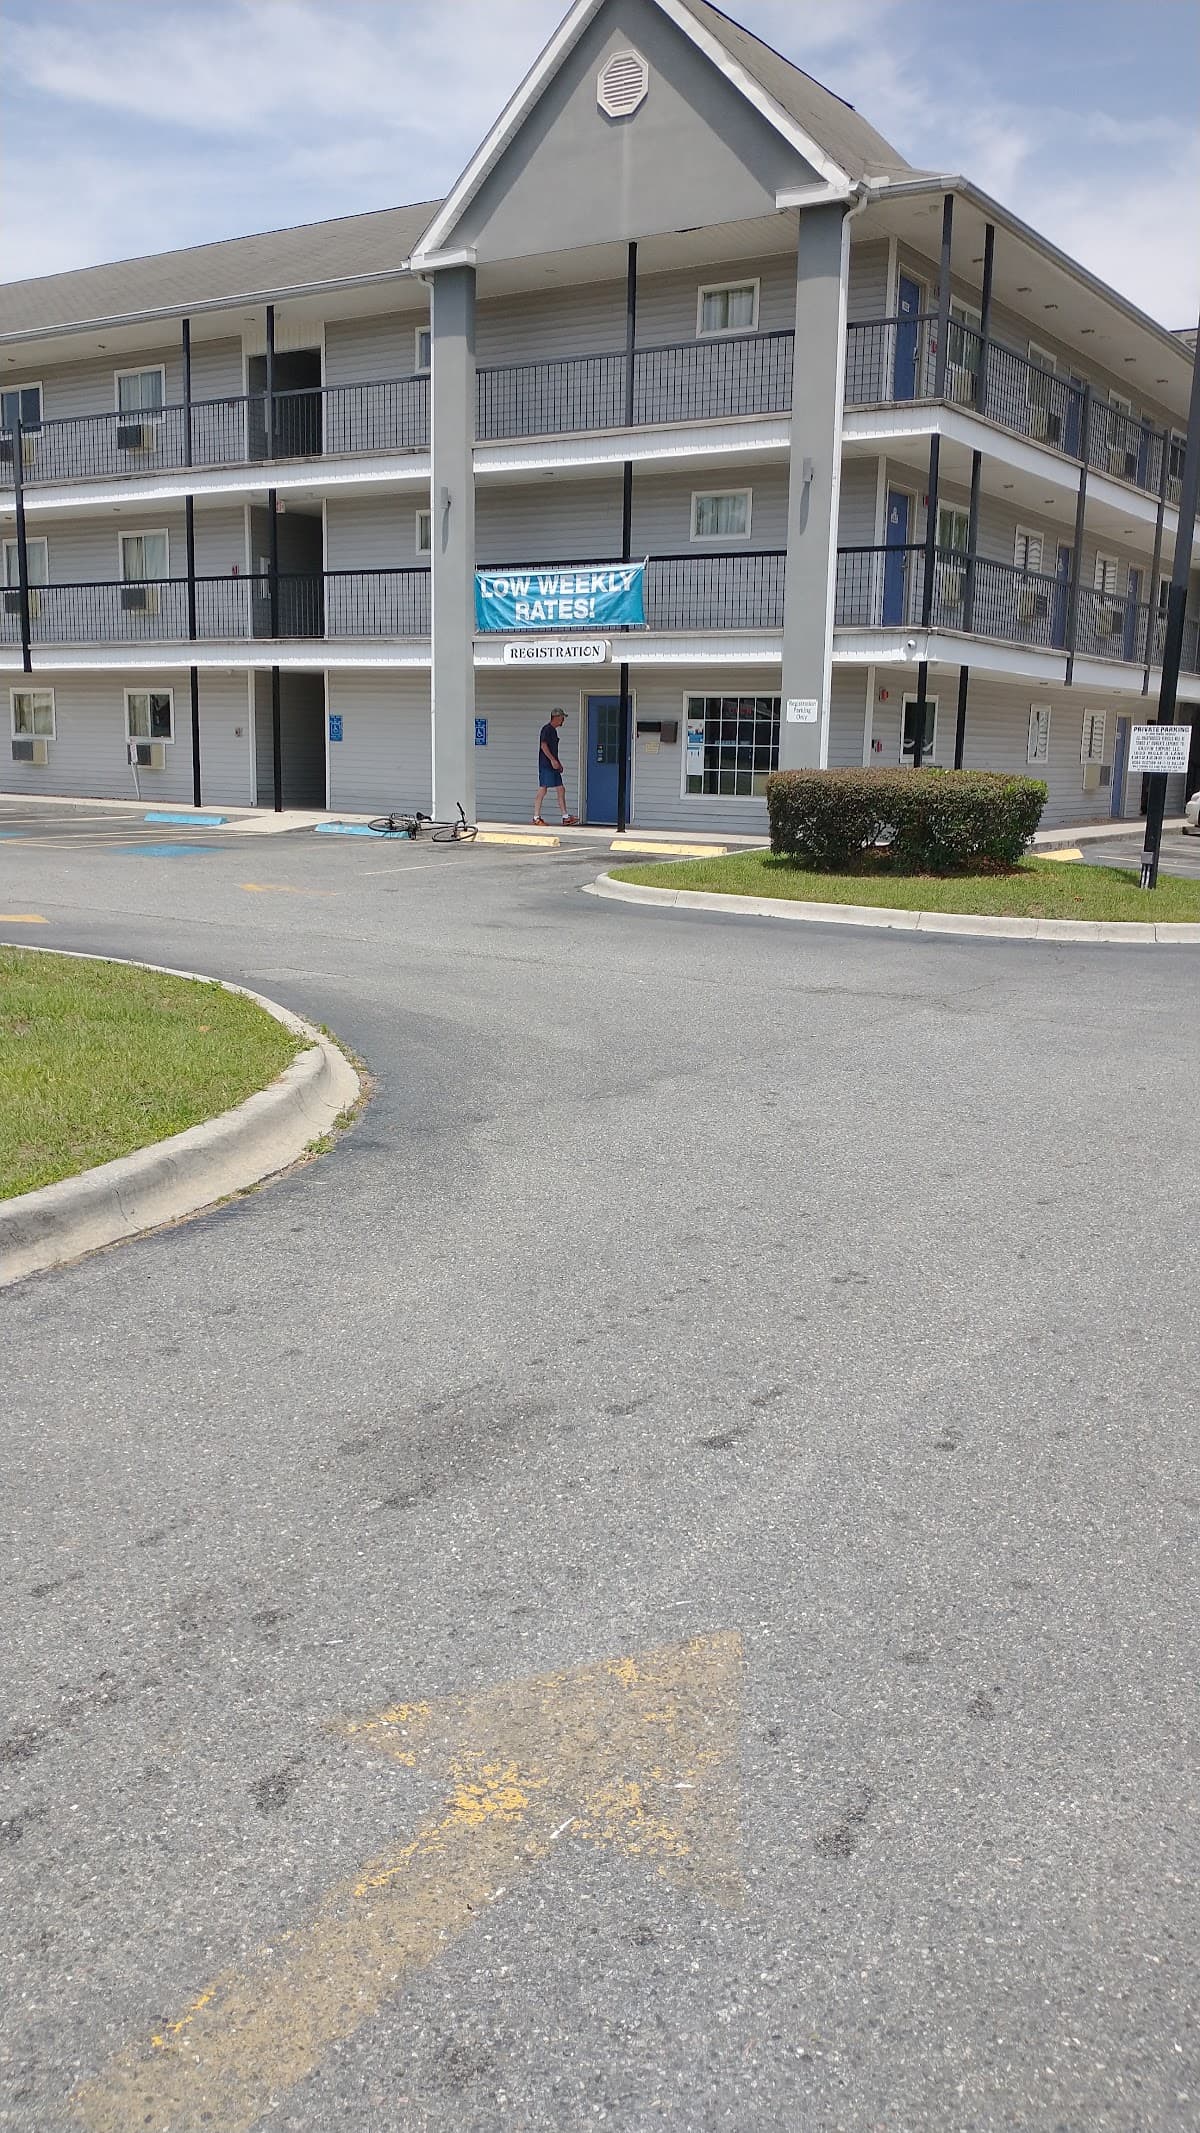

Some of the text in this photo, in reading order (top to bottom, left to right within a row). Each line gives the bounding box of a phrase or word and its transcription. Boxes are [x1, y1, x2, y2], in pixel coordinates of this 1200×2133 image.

[480, 571, 633, 598] LOW WEEKLY
[515, 598, 595, 621] RATES!
[510, 645, 600, 659] REGISTRATION
